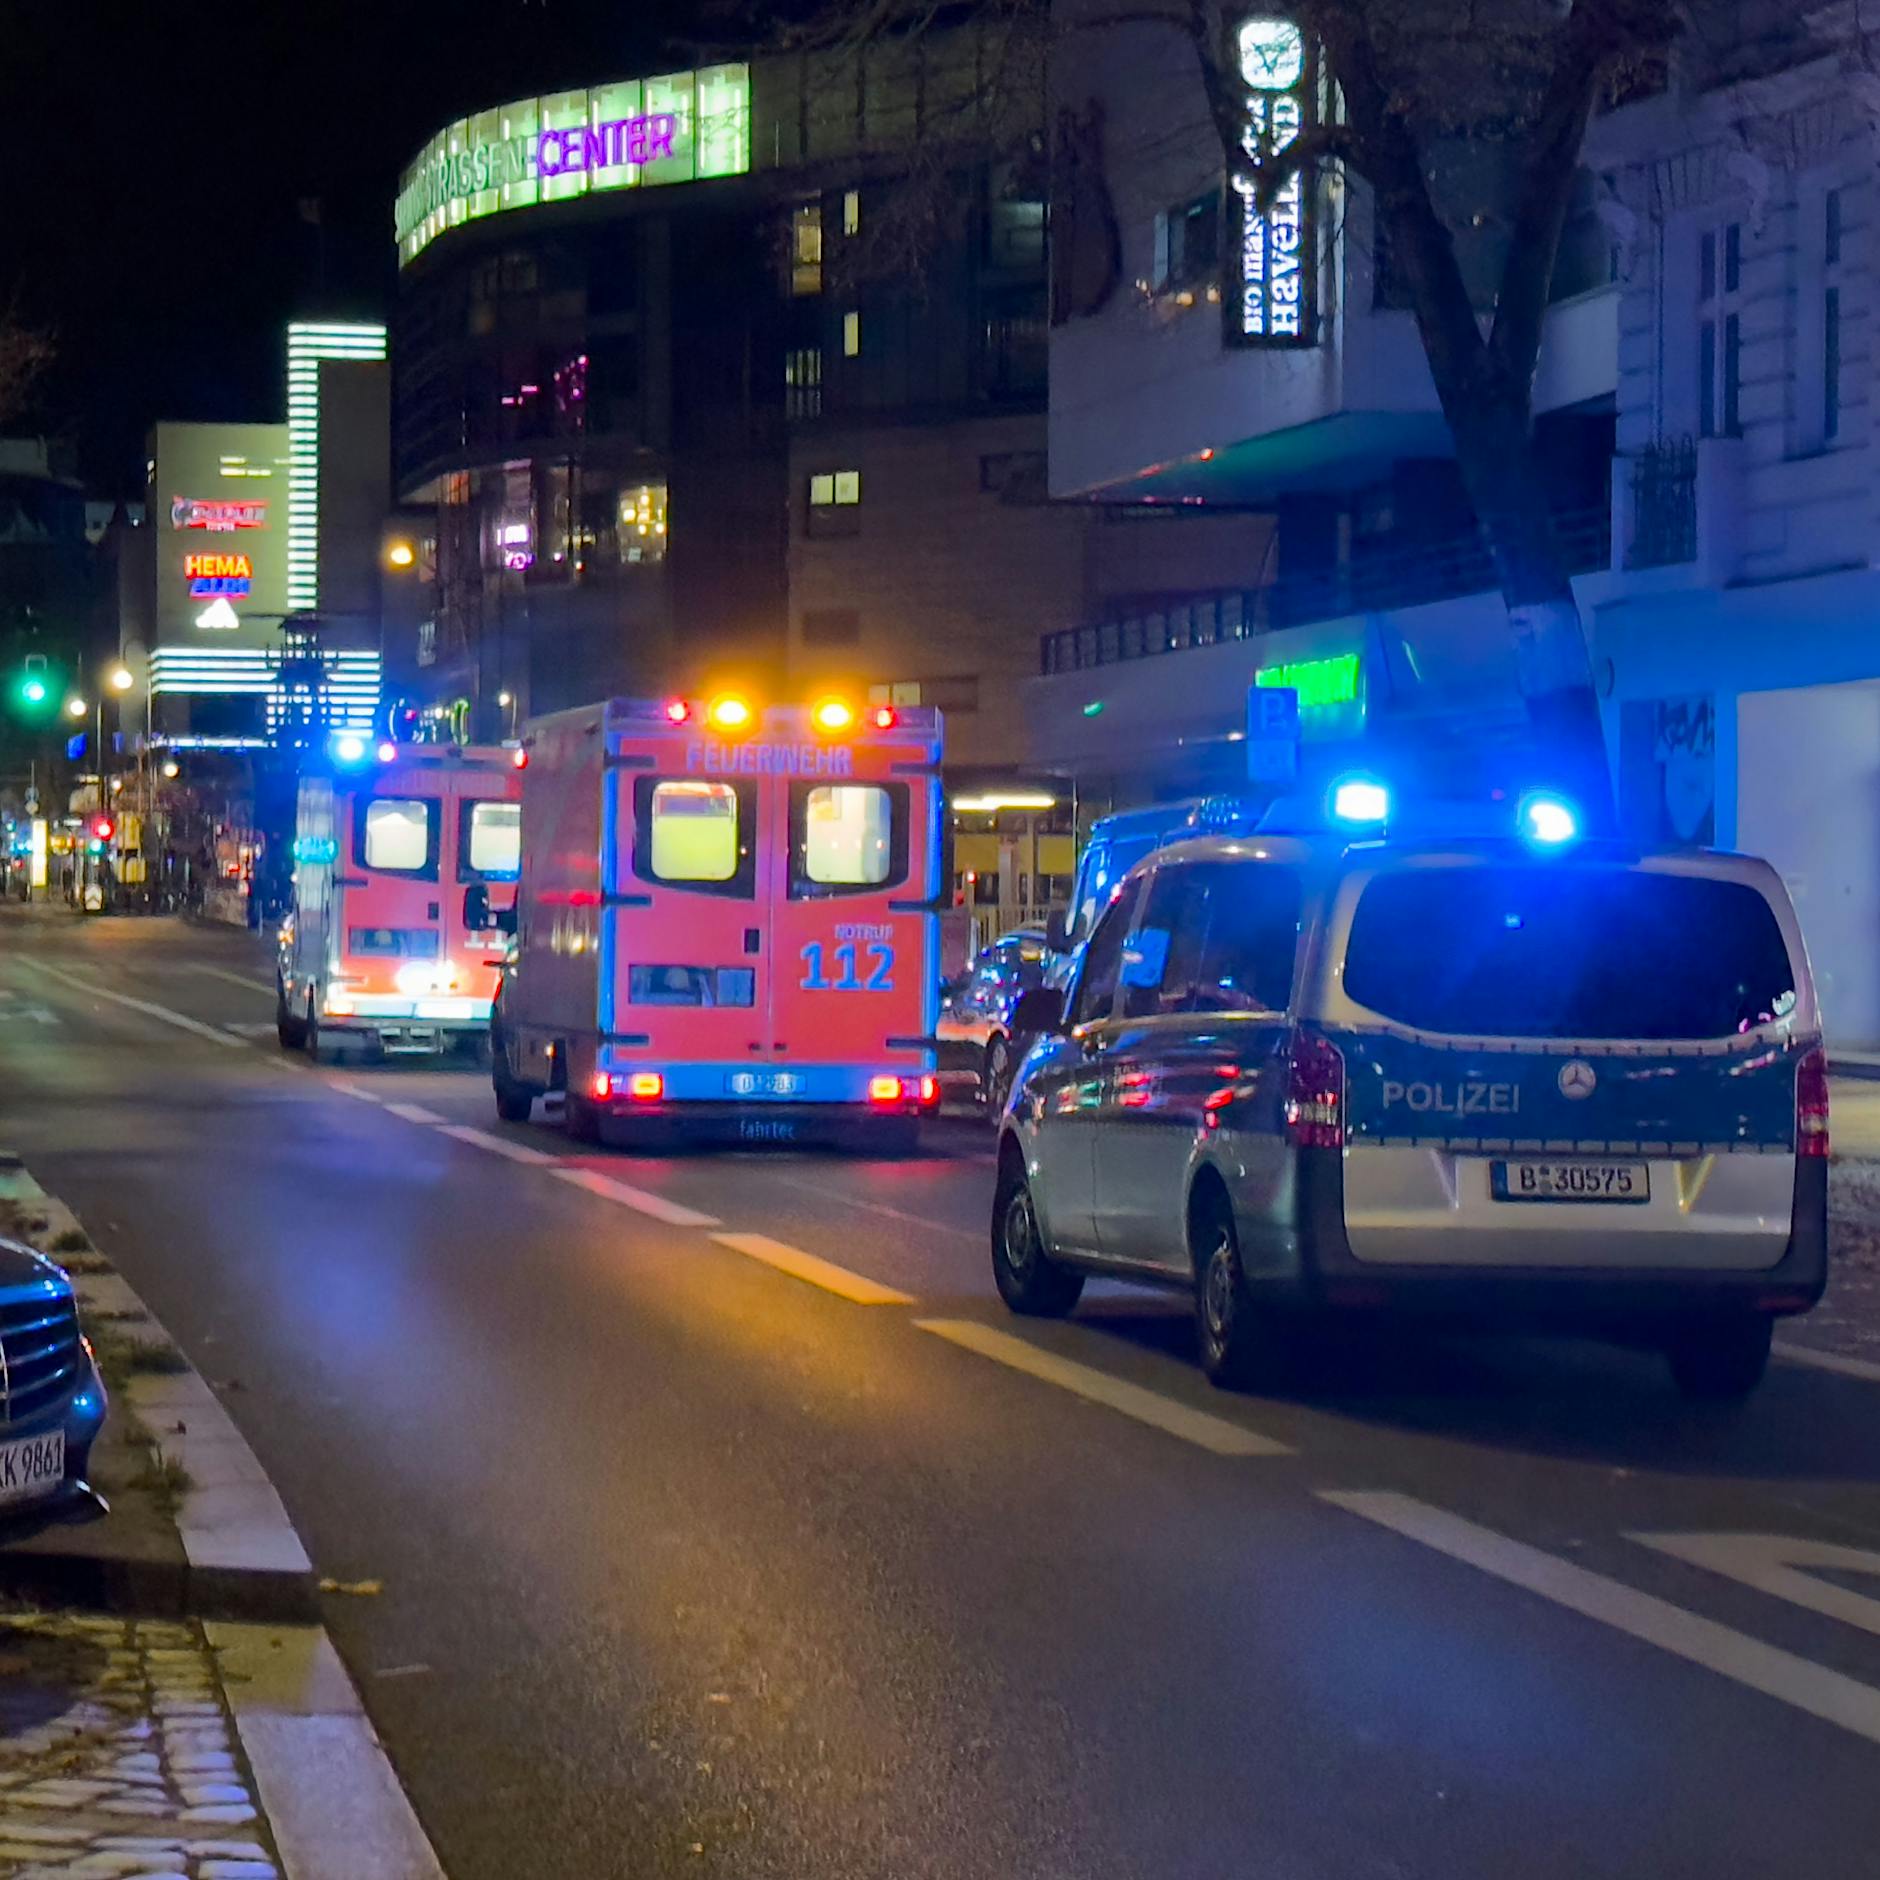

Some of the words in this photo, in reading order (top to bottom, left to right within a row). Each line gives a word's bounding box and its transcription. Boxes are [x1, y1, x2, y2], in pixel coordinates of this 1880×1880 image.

[537, 112, 677, 176] CENTER
[184, 554, 251, 578] HEMA
[686, 741, 852, 777] FEUERWEHR
[800, 943, 895, 991] 112
[1382, 1079, 1520, 1120] POLIZEI
[1520, 1164, 1537, 1191] B
[1554, 1166, 1634, 1195] 30575
[22, 1437, 62, 1484] 9861
